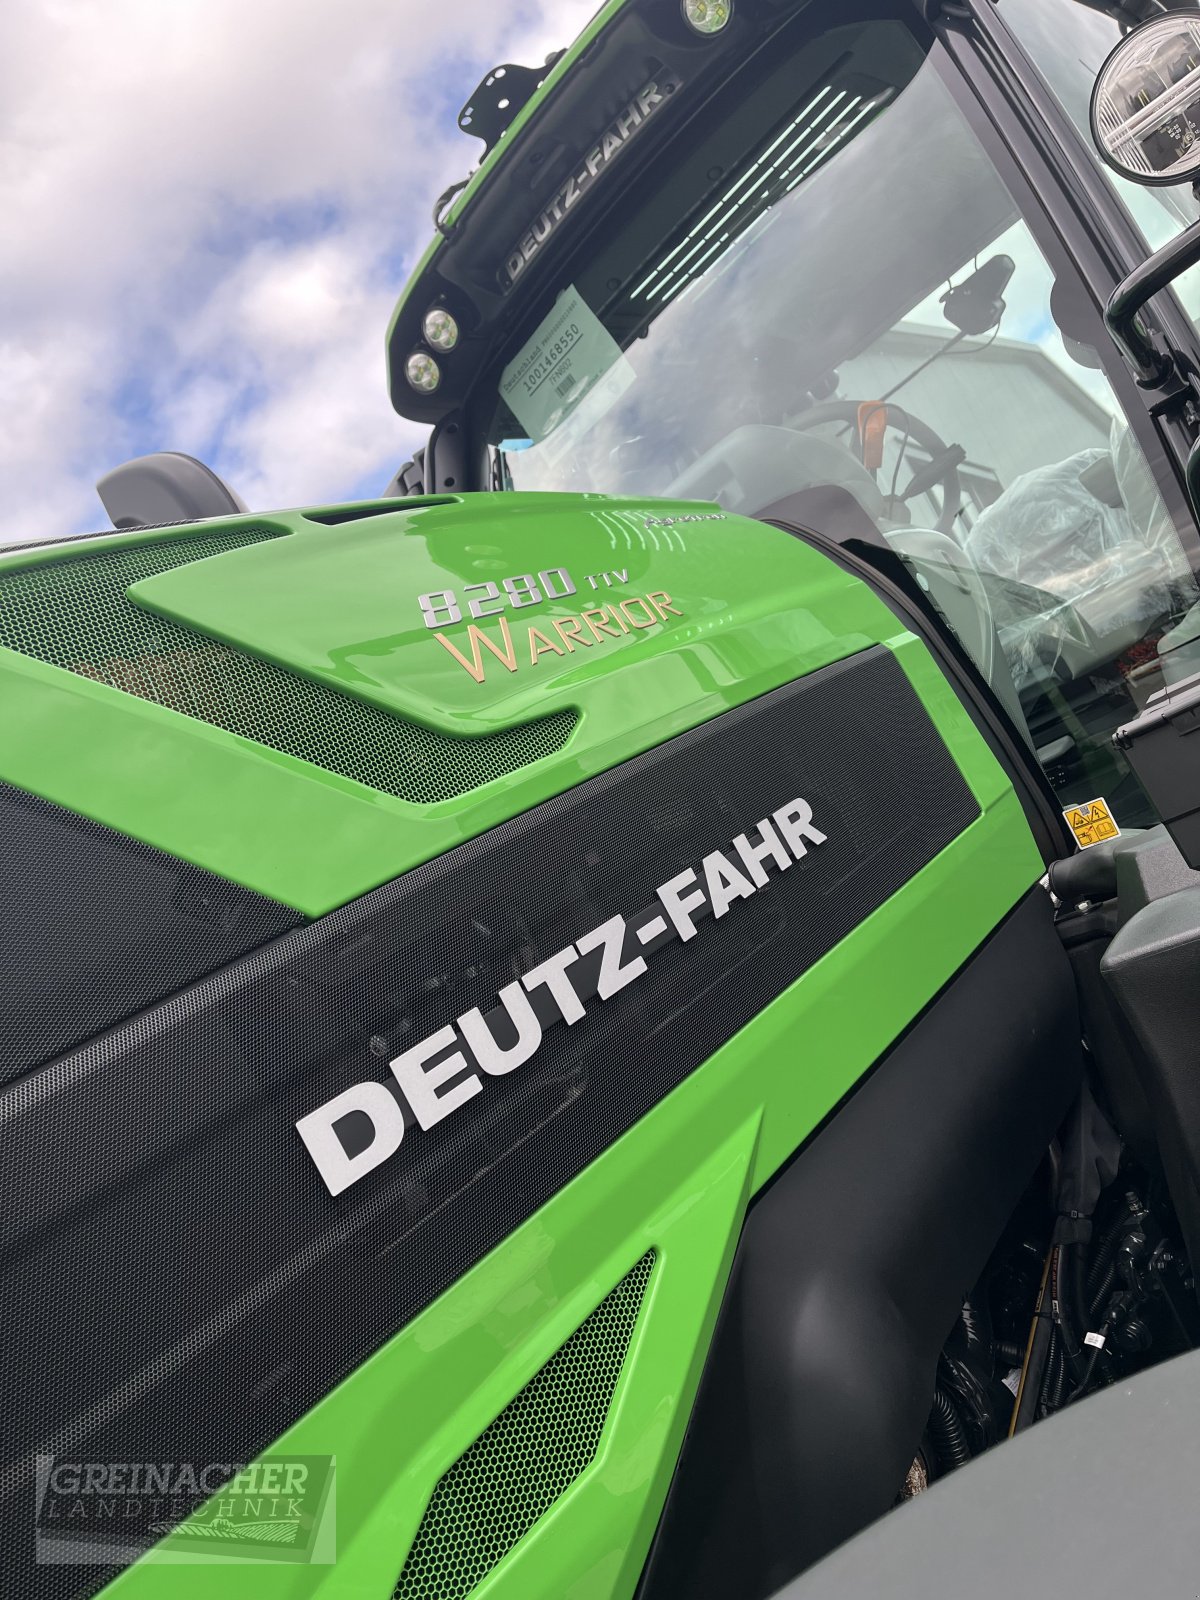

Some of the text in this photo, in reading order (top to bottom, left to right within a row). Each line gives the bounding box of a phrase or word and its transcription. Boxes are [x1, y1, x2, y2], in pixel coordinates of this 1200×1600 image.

[506, 81, 663, 281] DEUTZ-FAHR
[523, 323, 580, 392] 1001468550
[417, 566, 629, 630] 8280 TTV
[432, 590, 684, 684] WARRIOR
[295, 797, 828, 1197] DEUTZ-FAHR
